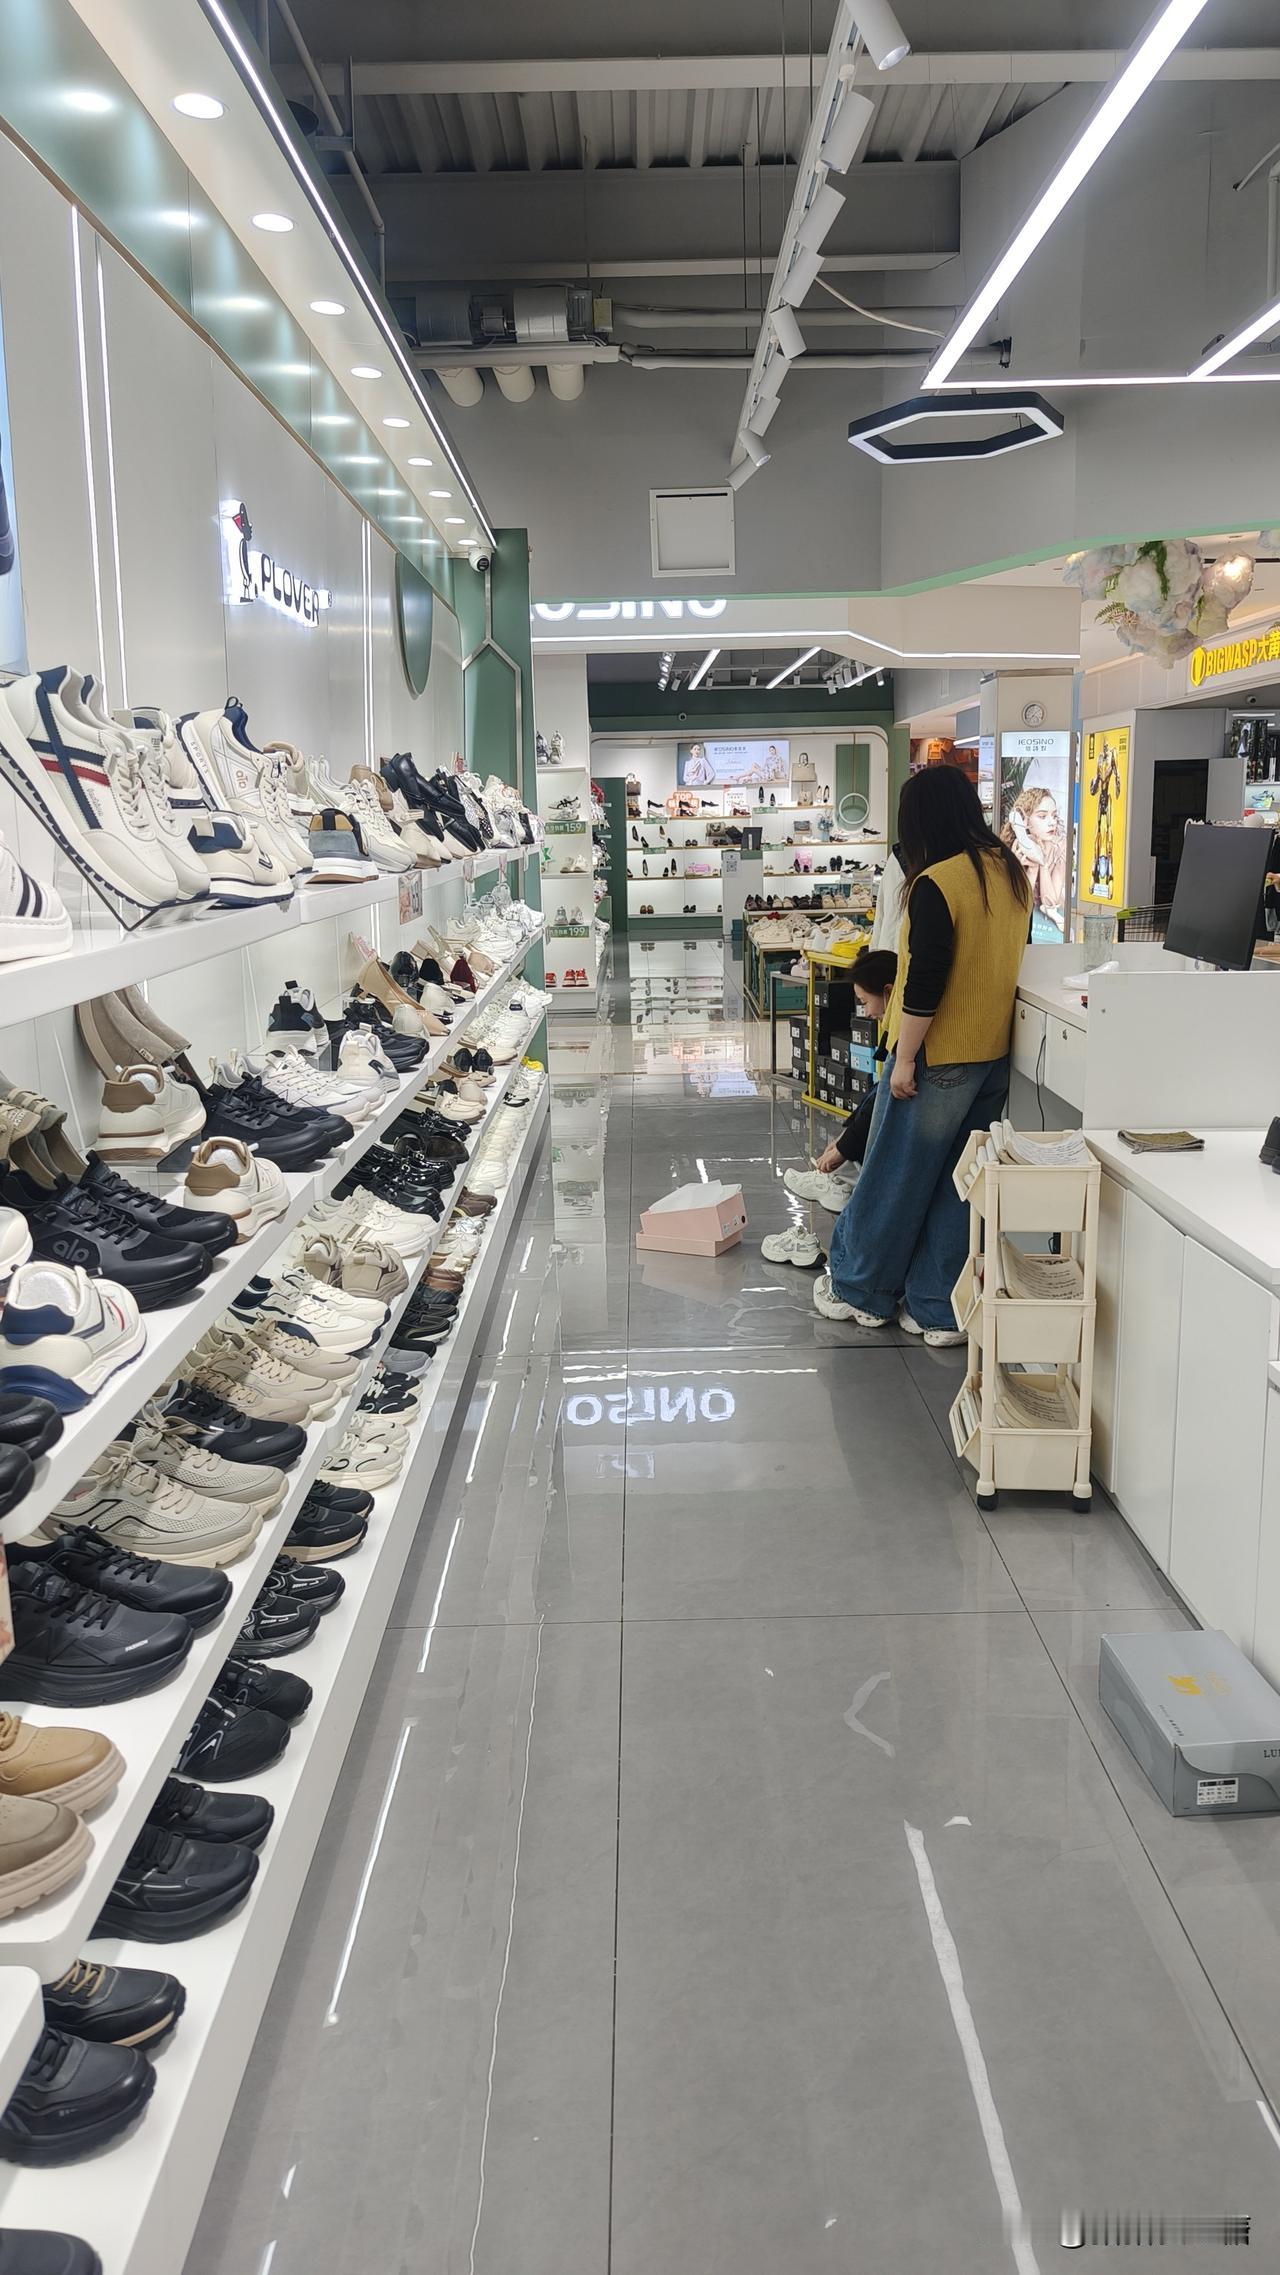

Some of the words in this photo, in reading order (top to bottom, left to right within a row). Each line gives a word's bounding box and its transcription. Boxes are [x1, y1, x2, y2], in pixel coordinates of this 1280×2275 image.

[261, 553, 319, 625] PLOVER
[1205, 639, 1257, 677] BIGWASP
[1264, 1749, 1280, 1758] LU
